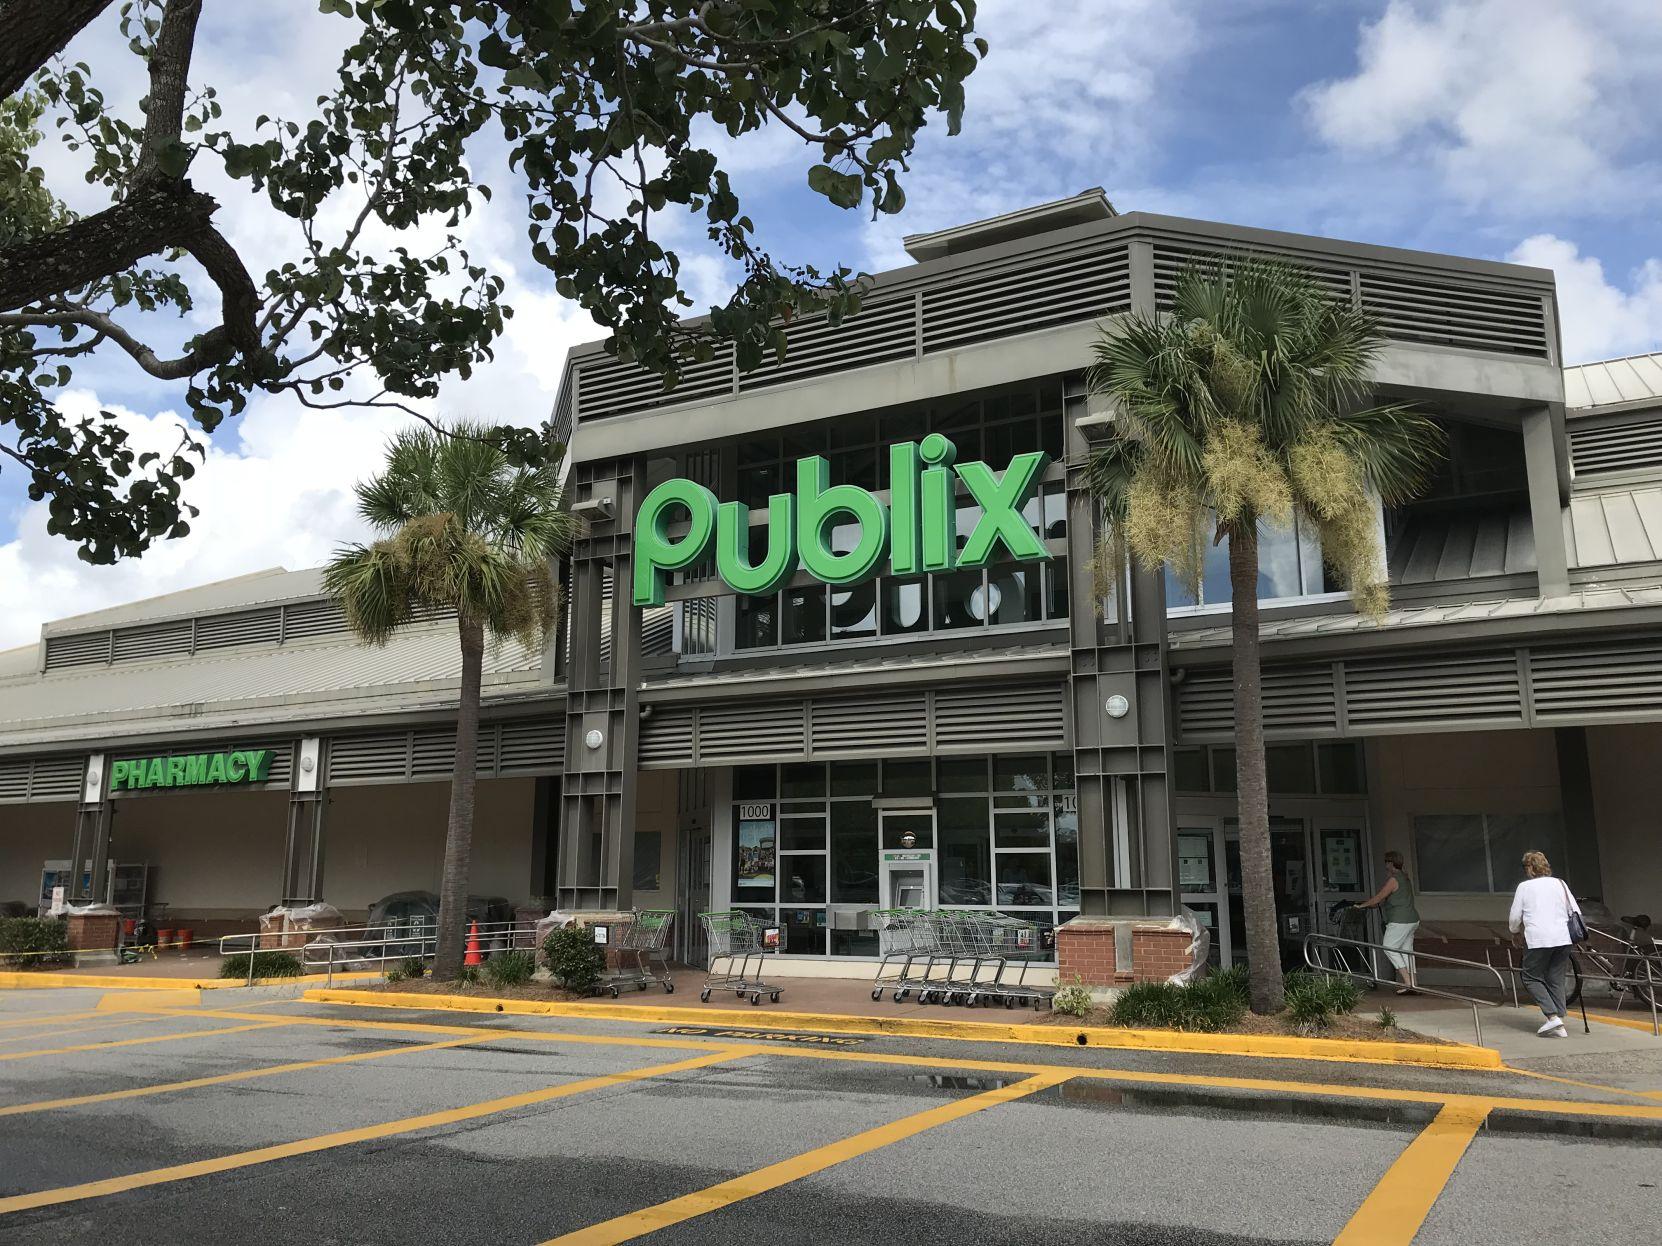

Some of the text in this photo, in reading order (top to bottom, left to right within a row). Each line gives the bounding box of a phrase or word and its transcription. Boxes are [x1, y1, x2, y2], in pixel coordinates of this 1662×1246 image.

[634, 433, 1053, 607] Publix
[111, 750, 268, 790] PHARMACY
[741, 805, 769, 818] 1000
[714, 1030, 865, 1045] PARKING
